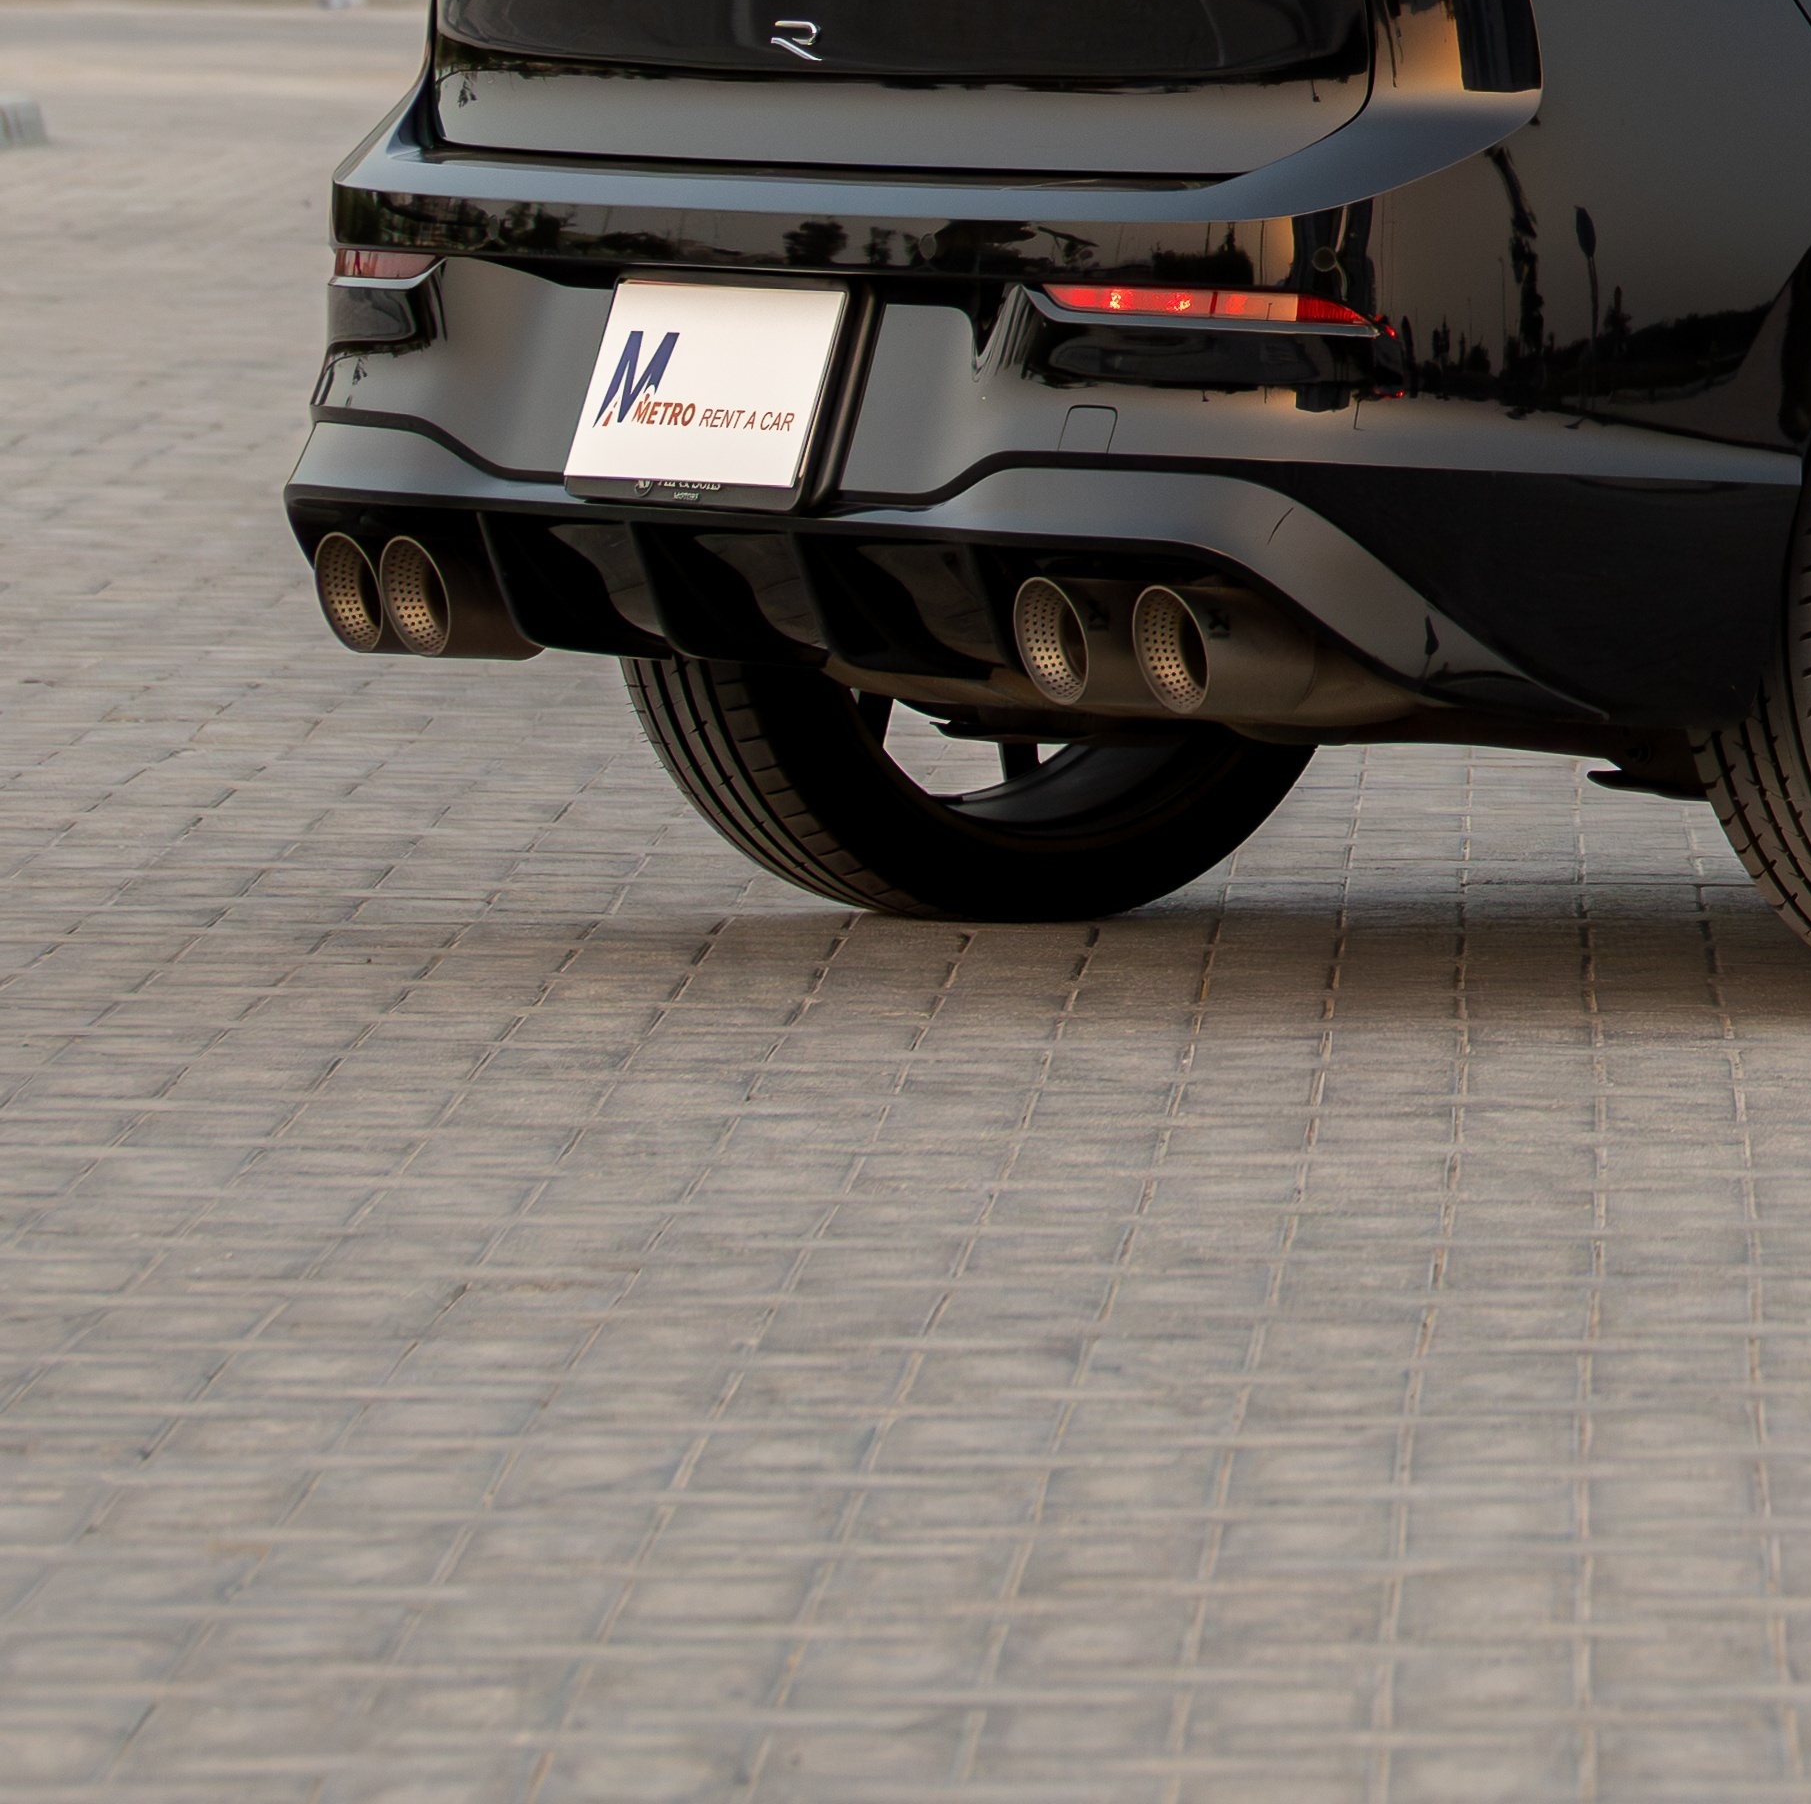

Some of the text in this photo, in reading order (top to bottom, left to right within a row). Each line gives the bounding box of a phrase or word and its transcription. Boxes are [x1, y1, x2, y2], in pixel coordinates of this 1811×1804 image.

[770, 20, 823, 62] R
[631, 400, 796, 432] METRO RENT A CAR
